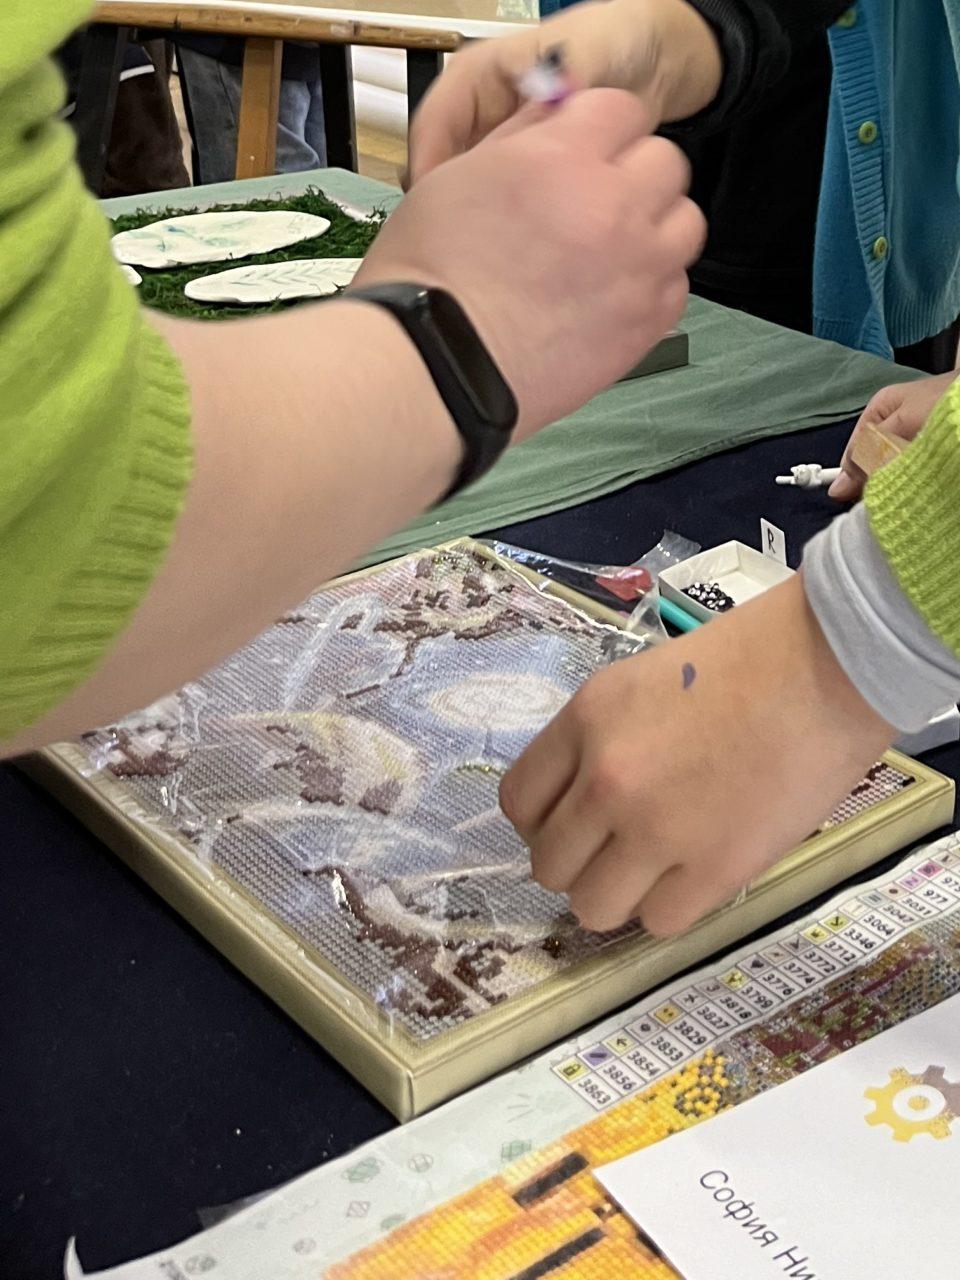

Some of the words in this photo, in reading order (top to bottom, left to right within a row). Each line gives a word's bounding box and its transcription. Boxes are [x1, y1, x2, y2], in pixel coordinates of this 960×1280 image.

[767, 528, 776, 554] R
[923, 889, 948, 904] 977
[863, 915, 896, 936] 3064
[844, 928, 877, 950] 3346
[824, 941, 856, 962] 3712
[762, 973, 795, 996] 3776
[741, 986, 774, 1009] 3799
[697, 1006, 730, 1029] 3827
[674, 1021, 707, 1045] 3829
[651, 1036, 684, 1061] 3853
[627, 1050, 661, 1076] 3854
[603, 1065, 637, 1090] 3856
[578, 1079, 611, 1104] 3863
[699, 1170, 780, 1248] София
